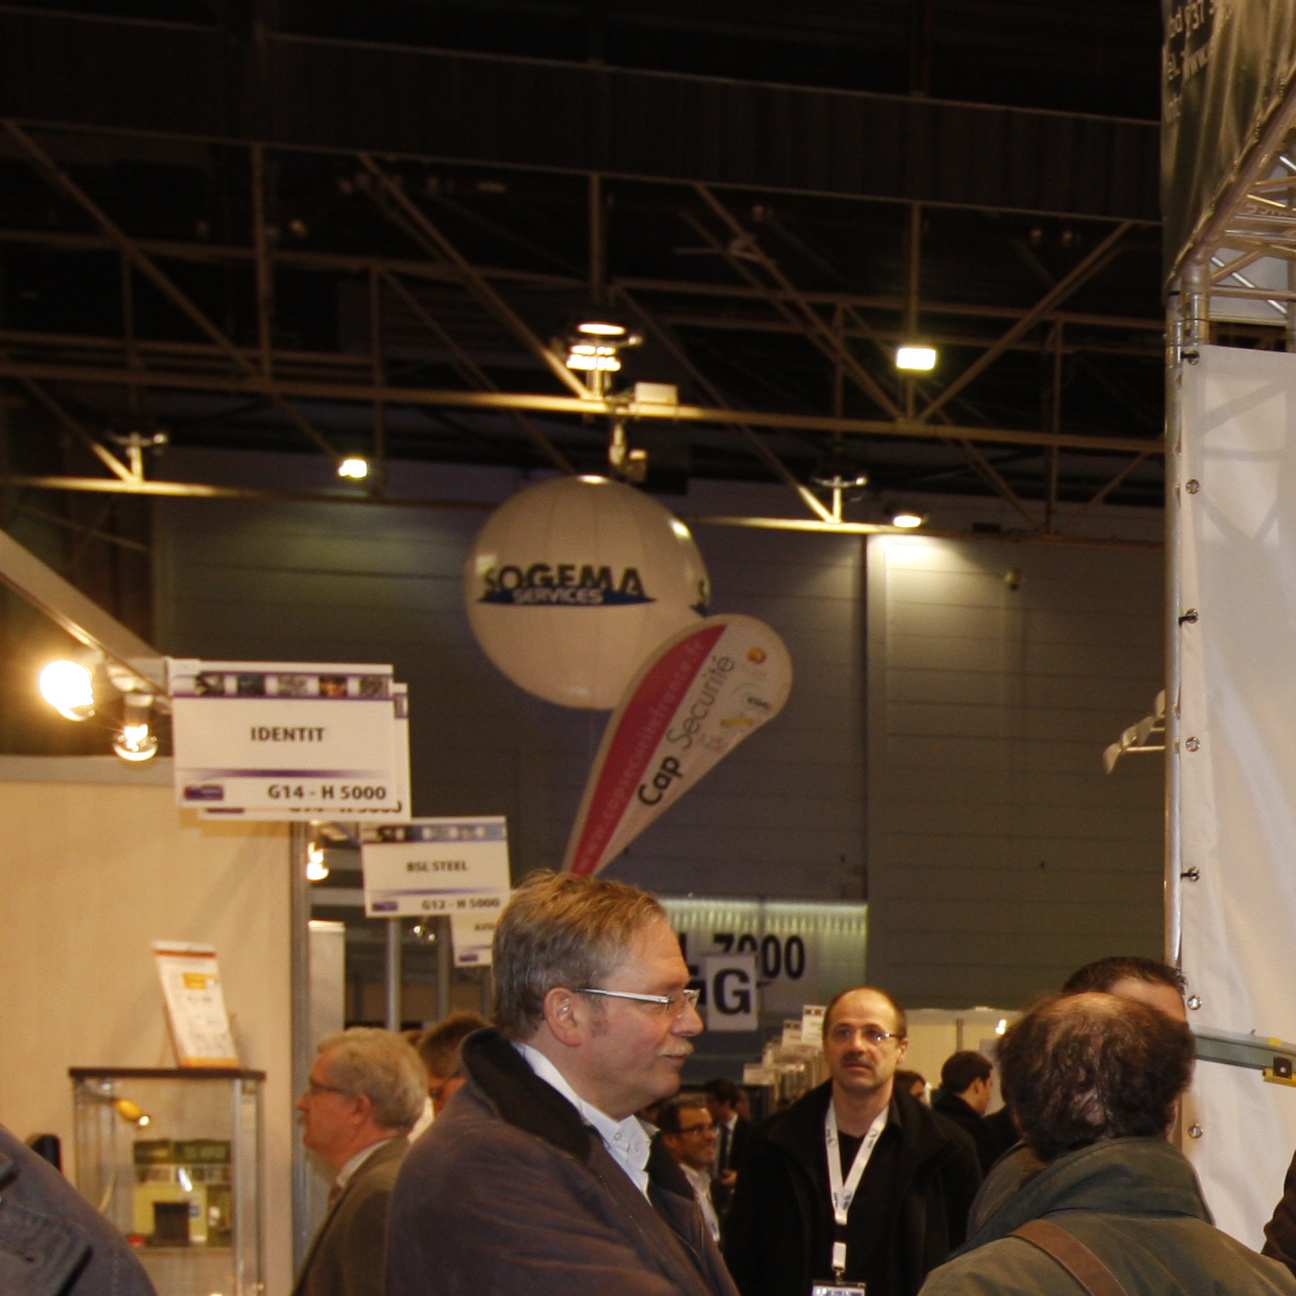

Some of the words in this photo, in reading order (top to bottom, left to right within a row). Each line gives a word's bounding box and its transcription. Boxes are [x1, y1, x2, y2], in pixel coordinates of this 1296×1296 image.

[483, 562, 646, 598] SOGEMA
[250, 726, 326, 743] IDENTIT
[268, 784, 304, 800] G14
[321, 785, 336, 800] H
[341, 785, 387, 801] 5000
[637, 755, 683, 806] Cap
[712, 967, 751, 1015] G
